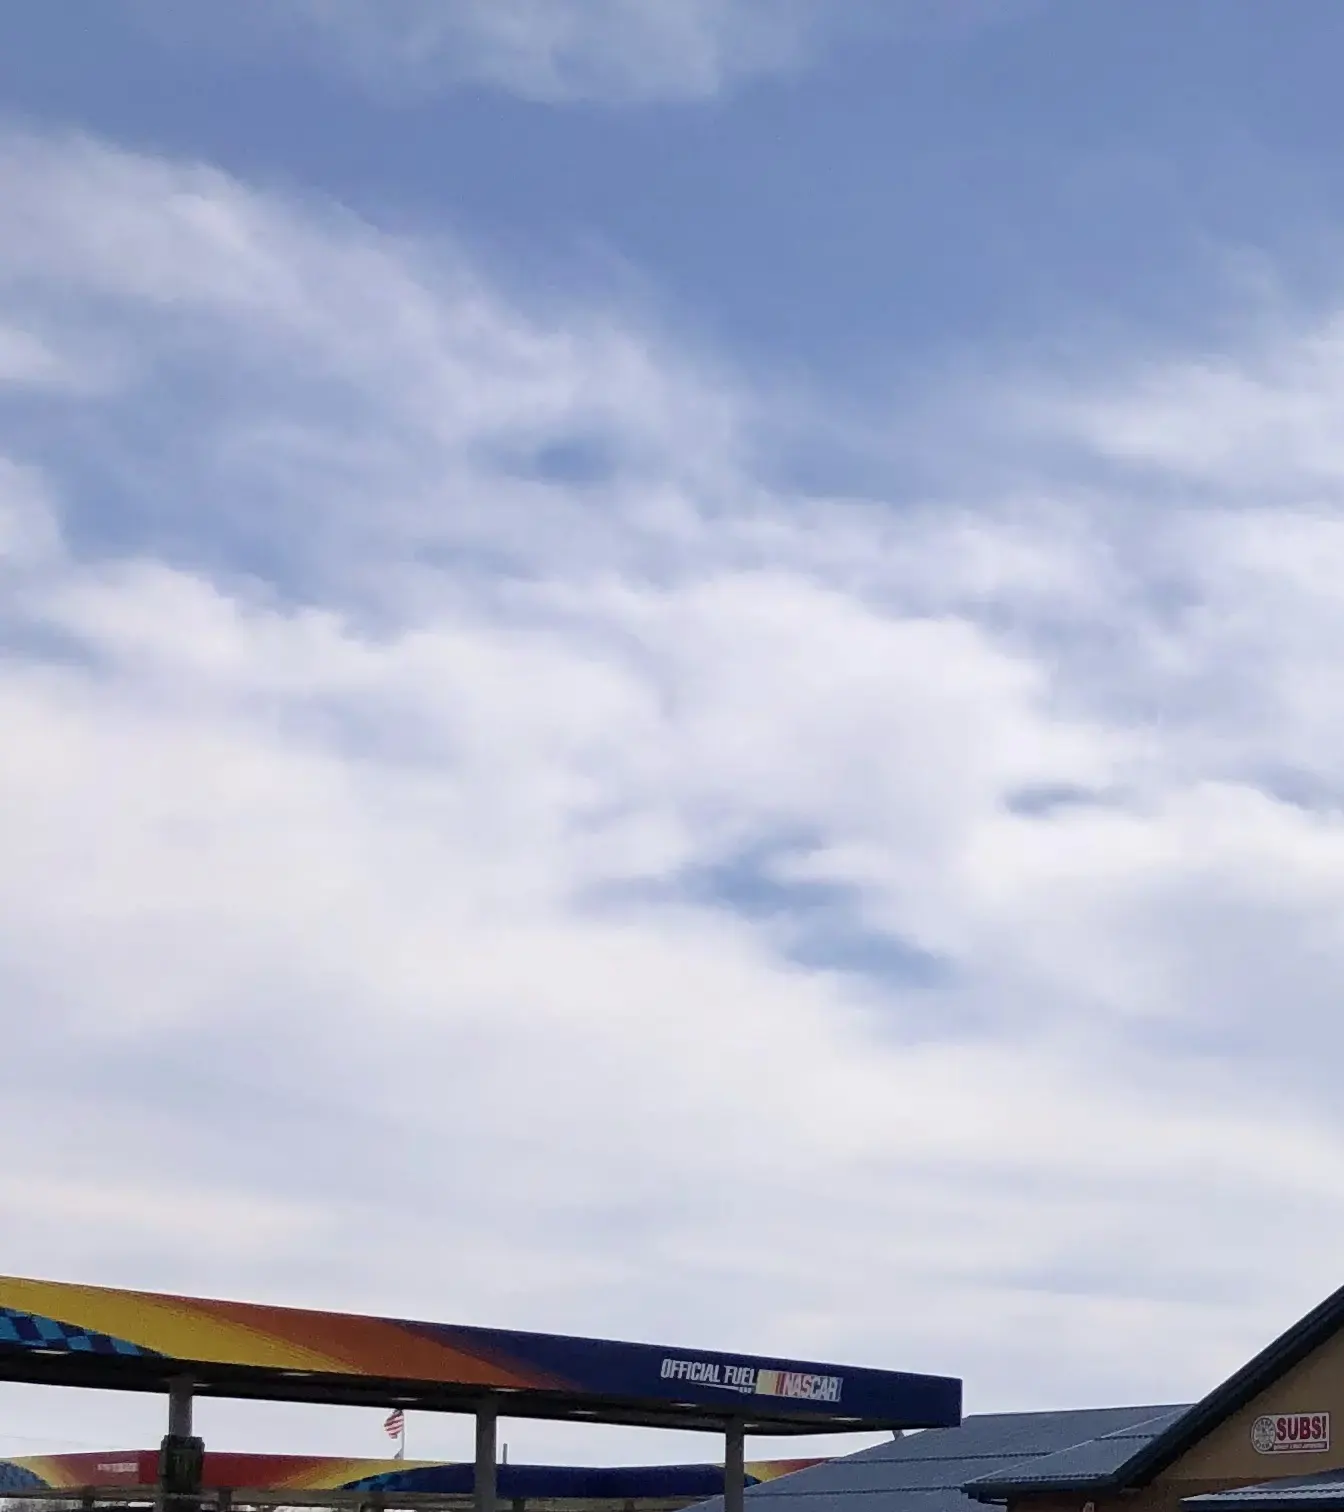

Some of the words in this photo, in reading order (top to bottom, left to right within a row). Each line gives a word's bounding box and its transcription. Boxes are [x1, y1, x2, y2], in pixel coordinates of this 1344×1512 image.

[660, 1358, 720, 1383] OFFICIAL
[724, 1365, 756, 1386] FUEL
[782, 1373, 840, 1401] NASCAR
[1277, 1415, 1327, 1441] SUBS!
